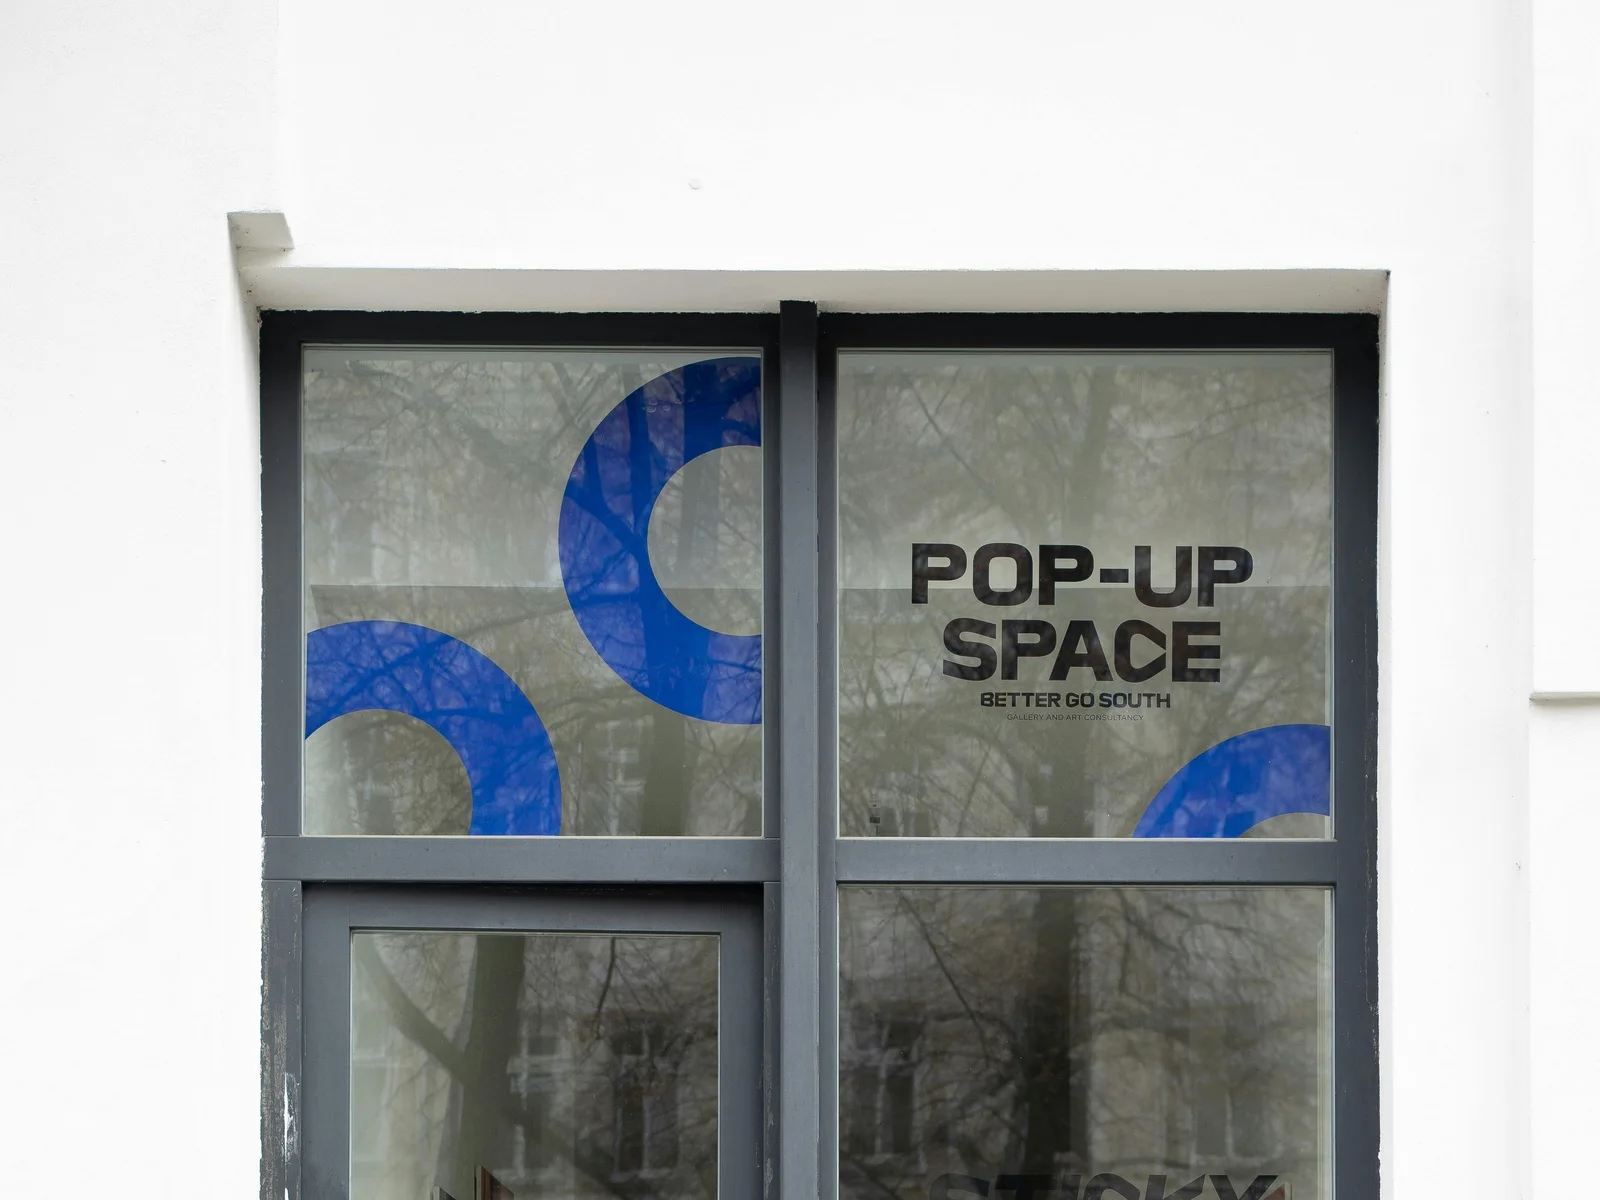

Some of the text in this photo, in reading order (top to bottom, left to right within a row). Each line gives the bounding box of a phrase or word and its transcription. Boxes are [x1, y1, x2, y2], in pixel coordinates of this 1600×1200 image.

[911, 542, 1254, 608] POP-UP
[942, 617, 1221, 684] SPACE
[980, 692, 1171, 709] BETTER GO SOUTH
[1006, 713, 1144, 721] GALLERY AND ART CONSULTANCY
